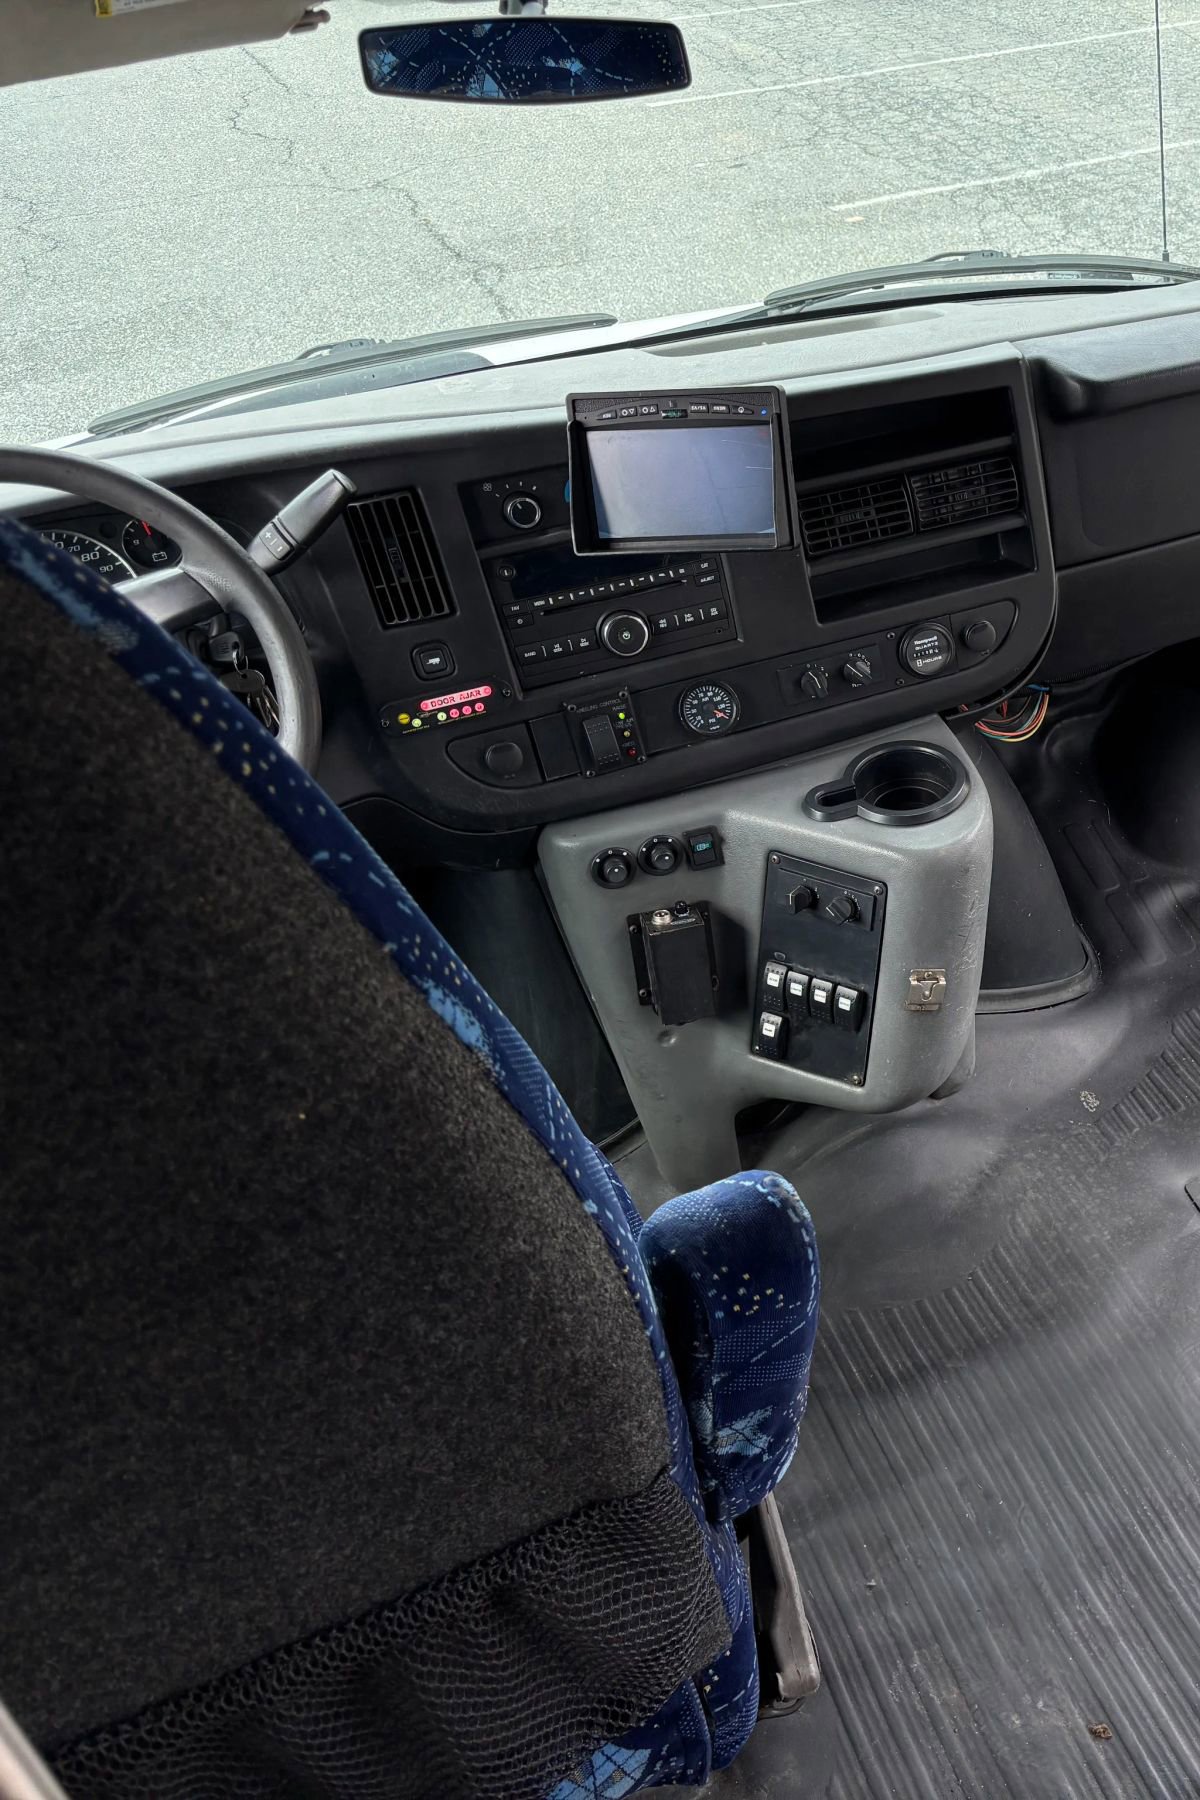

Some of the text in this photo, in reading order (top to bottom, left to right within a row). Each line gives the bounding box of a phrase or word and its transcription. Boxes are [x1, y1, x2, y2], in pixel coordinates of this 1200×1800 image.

[68, 545, 81, 553] 70
[81, 551, 99, 562] 80
[99, 564, 113, 573] 90
[915, 641, 939, 651] QUARTZ
[923, 655, 942, 664] HOURS
[430, 689, 482, 708] DOOR AJAR
